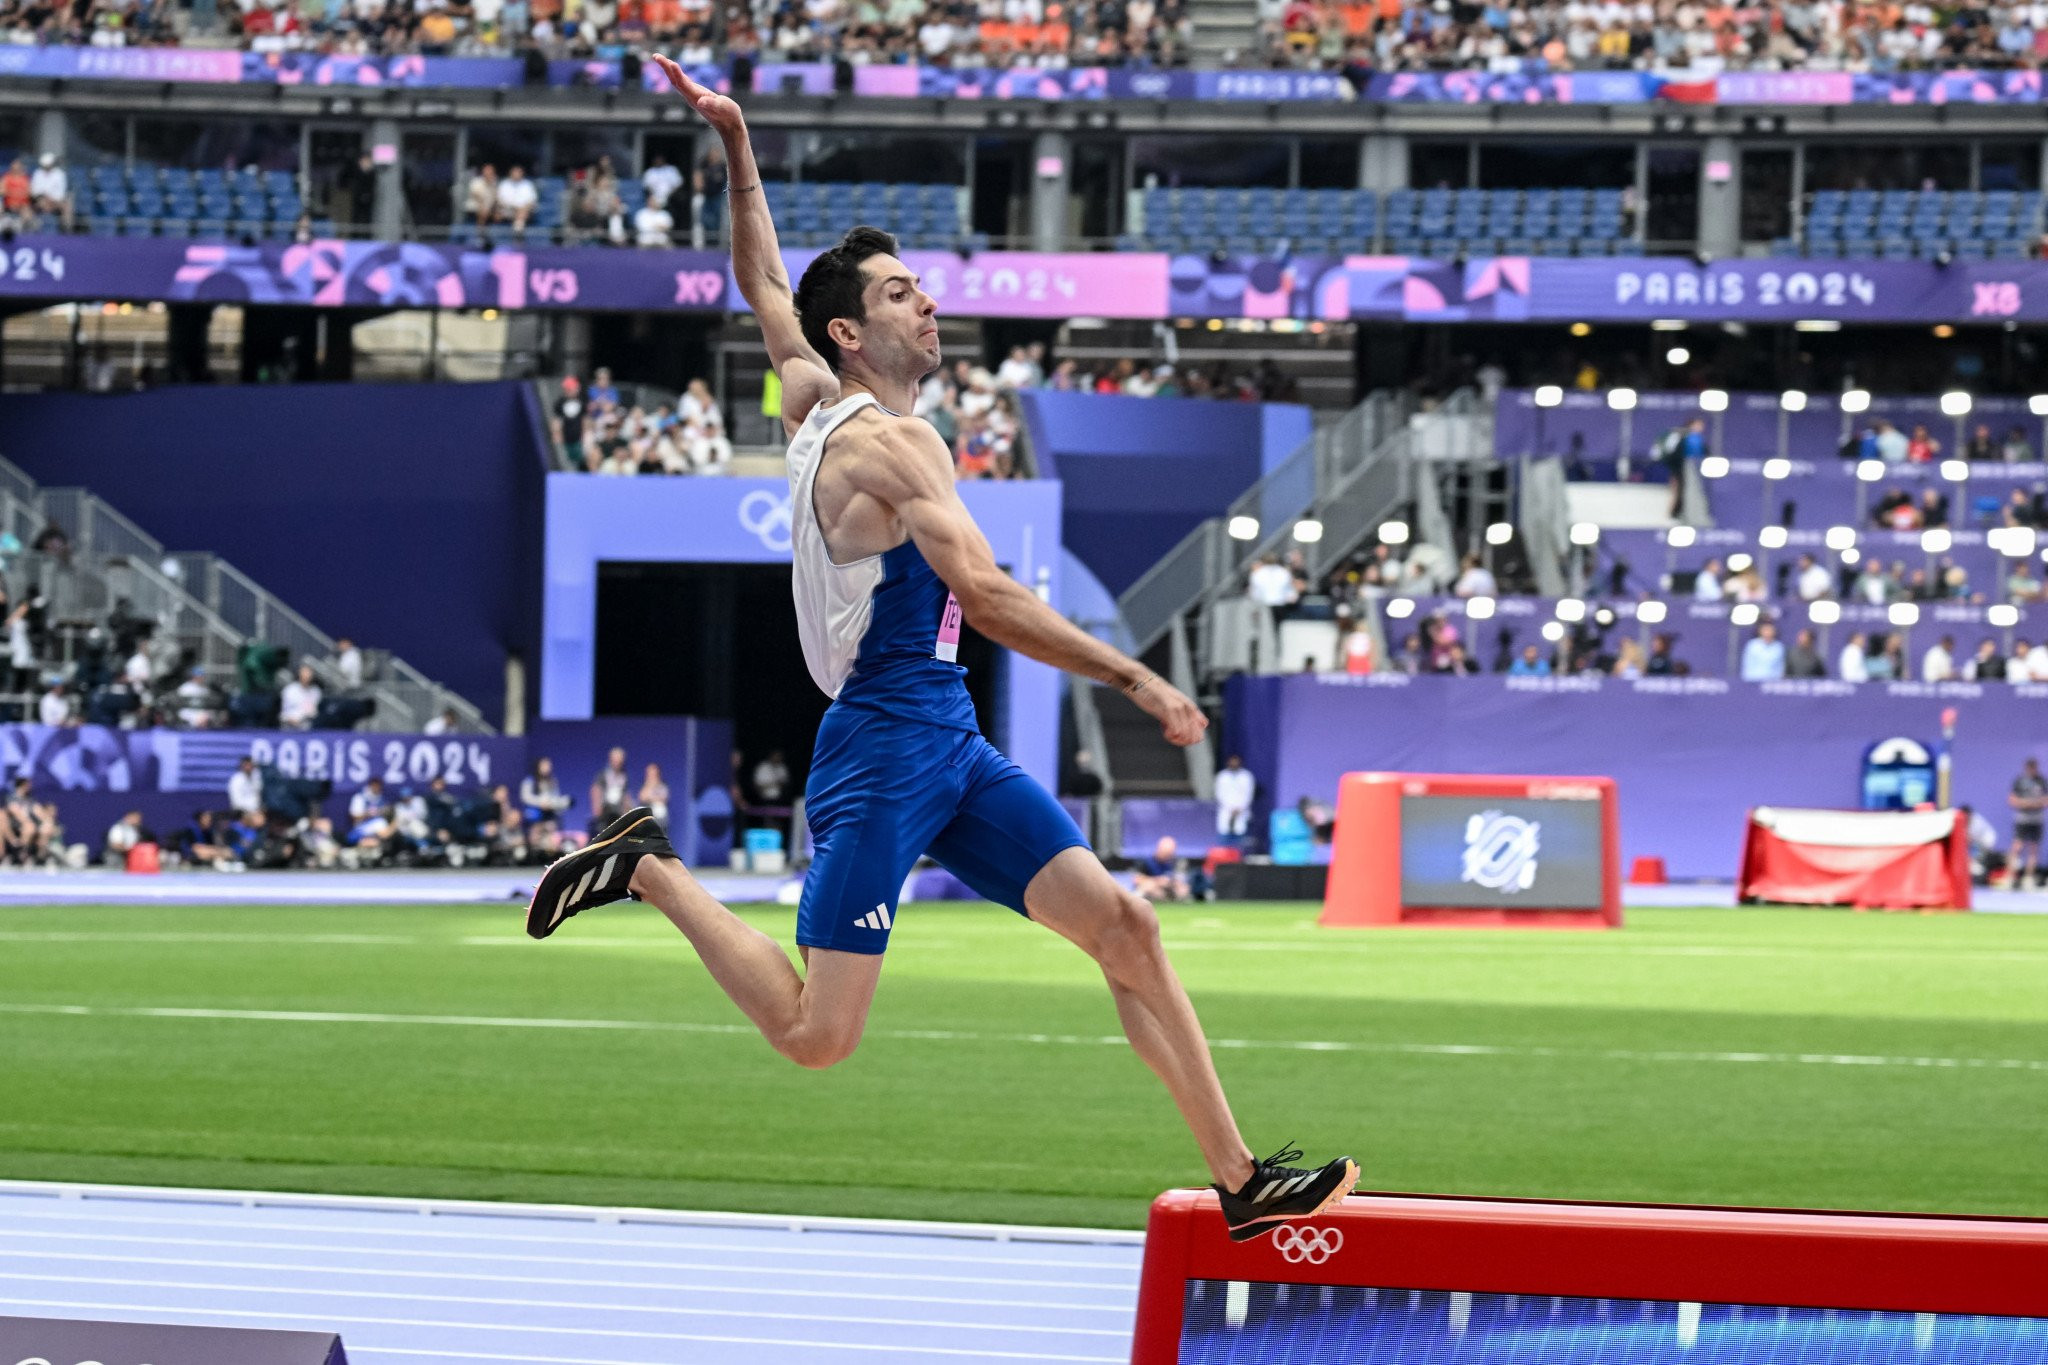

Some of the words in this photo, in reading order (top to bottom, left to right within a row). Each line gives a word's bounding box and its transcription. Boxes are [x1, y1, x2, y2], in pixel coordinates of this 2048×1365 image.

[0, 246, 65, 281] 24
[675, 269, 724, 304] X9
[961, 267, 1077, 300] 2024
[1757, 271, 1876, 306] 2024
[383, 740, 491, 786] 2024
